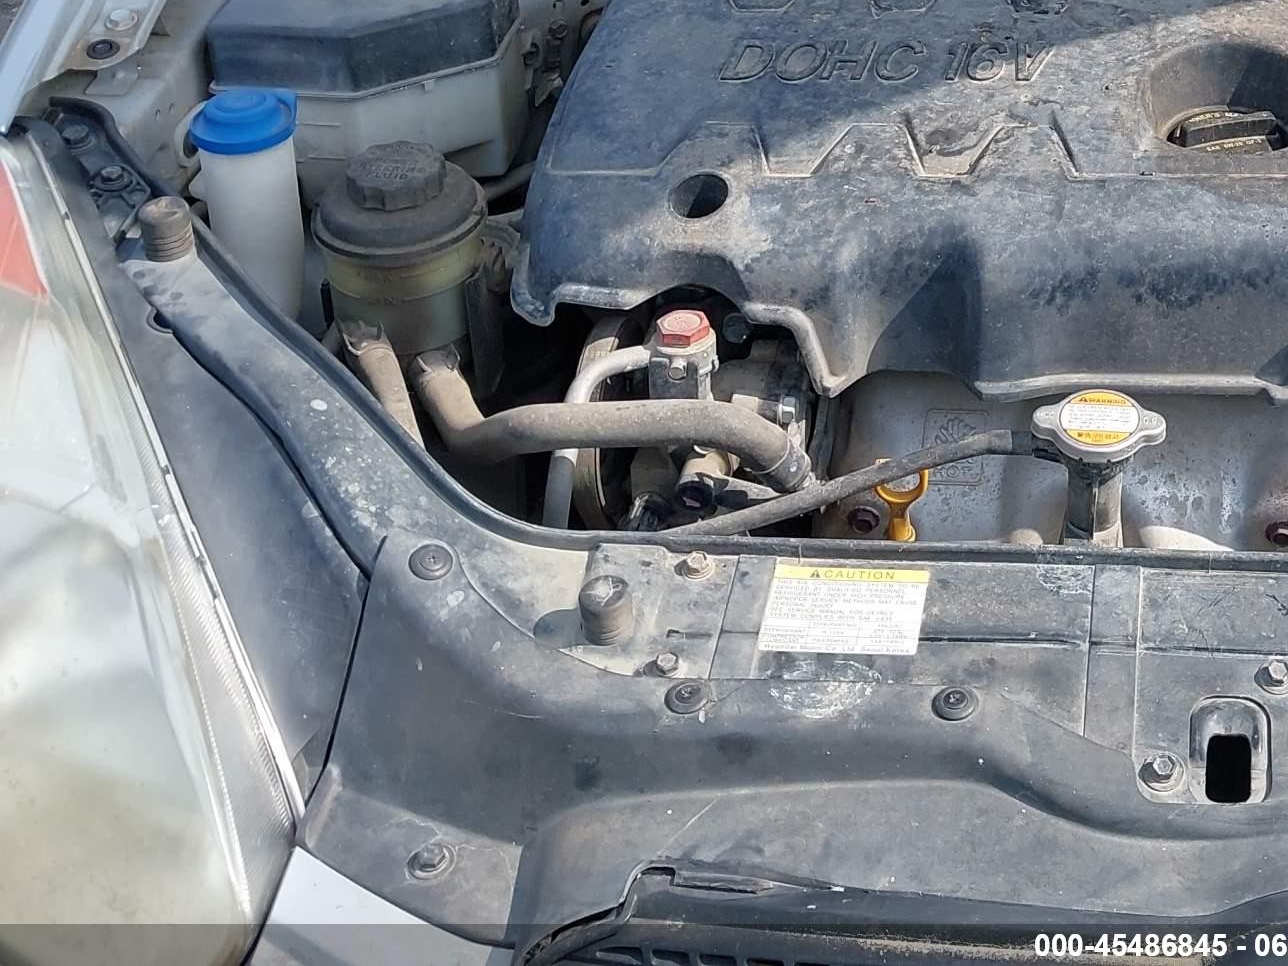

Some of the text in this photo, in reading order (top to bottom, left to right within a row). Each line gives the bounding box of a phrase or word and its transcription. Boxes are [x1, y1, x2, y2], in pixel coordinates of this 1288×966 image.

[719, 40, 1055, 83] DOHC 16V
[1089, 397, 1127, 405] WARNING
[824, 569, 896, 580] CAUTION
